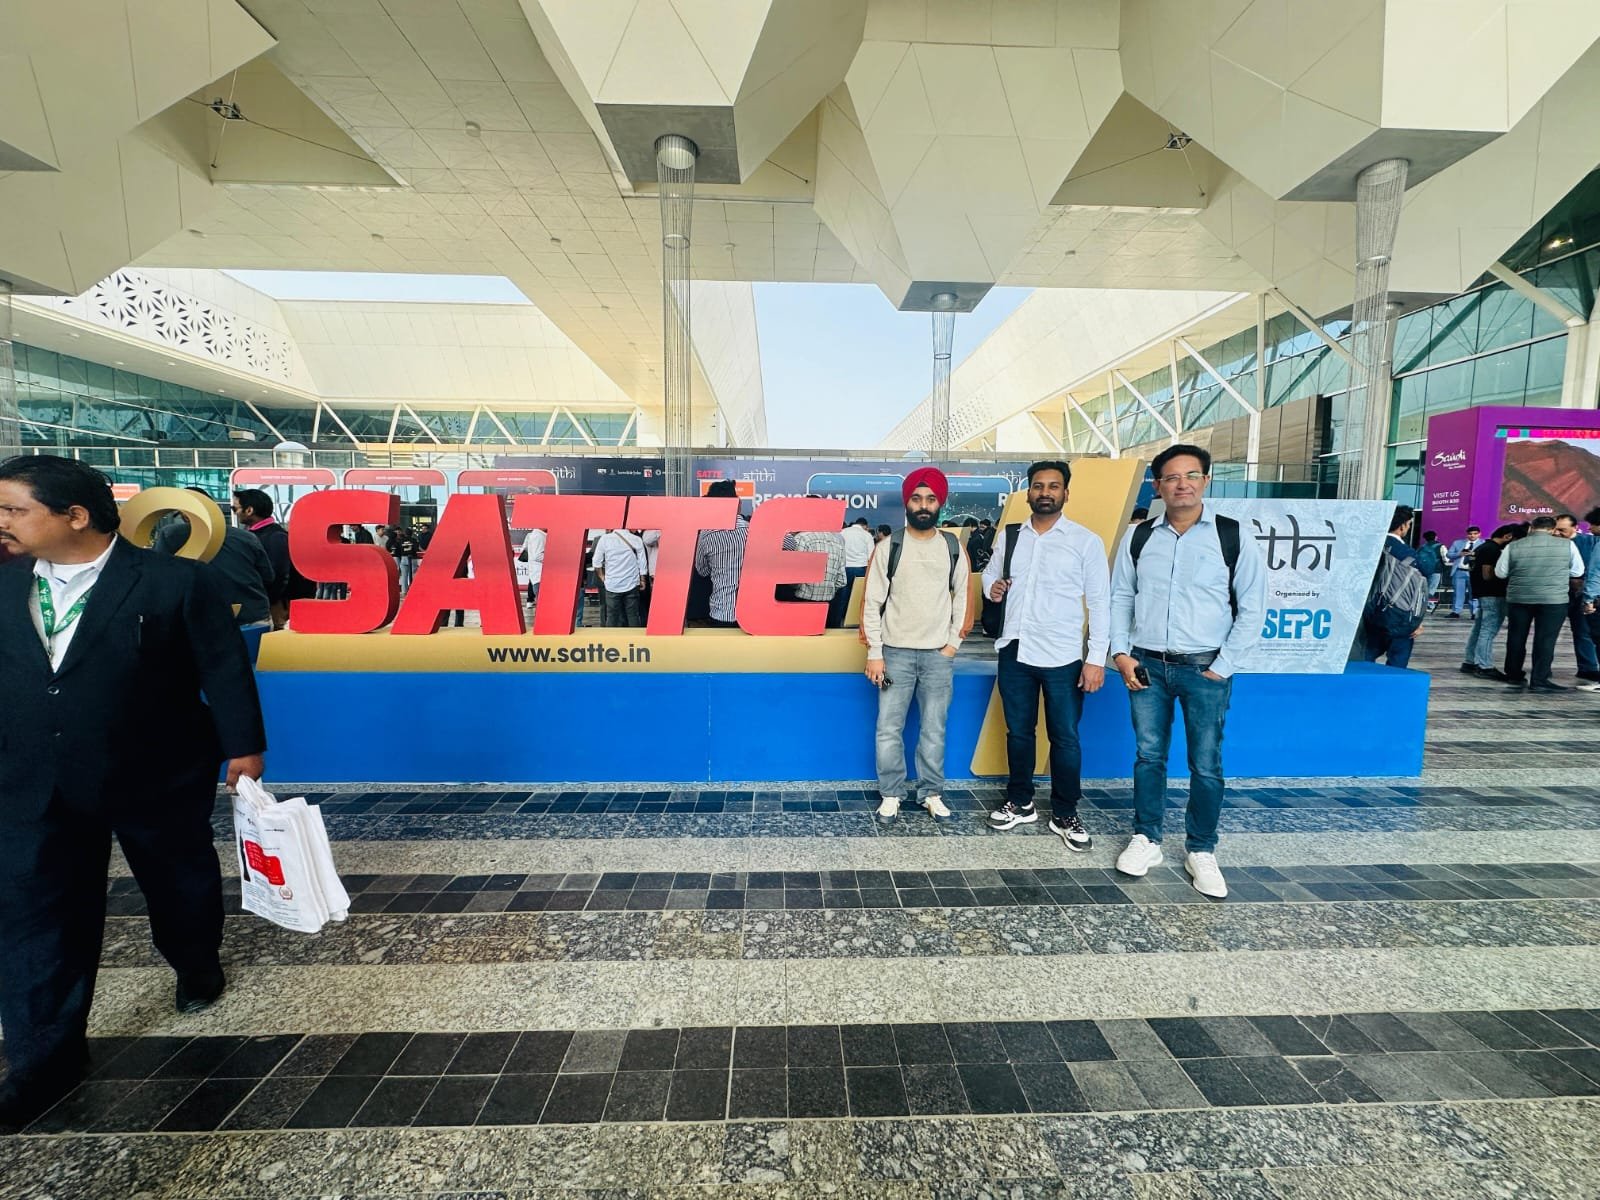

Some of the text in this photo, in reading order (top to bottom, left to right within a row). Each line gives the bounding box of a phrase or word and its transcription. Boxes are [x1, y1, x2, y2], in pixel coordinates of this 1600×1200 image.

[289, 489, 846, 636] SATTE
[1311, 590, 1320, 598] by
[1261, 608, 1332, 640] SEPC
[487, 643, 651, 663] www.satte.in
